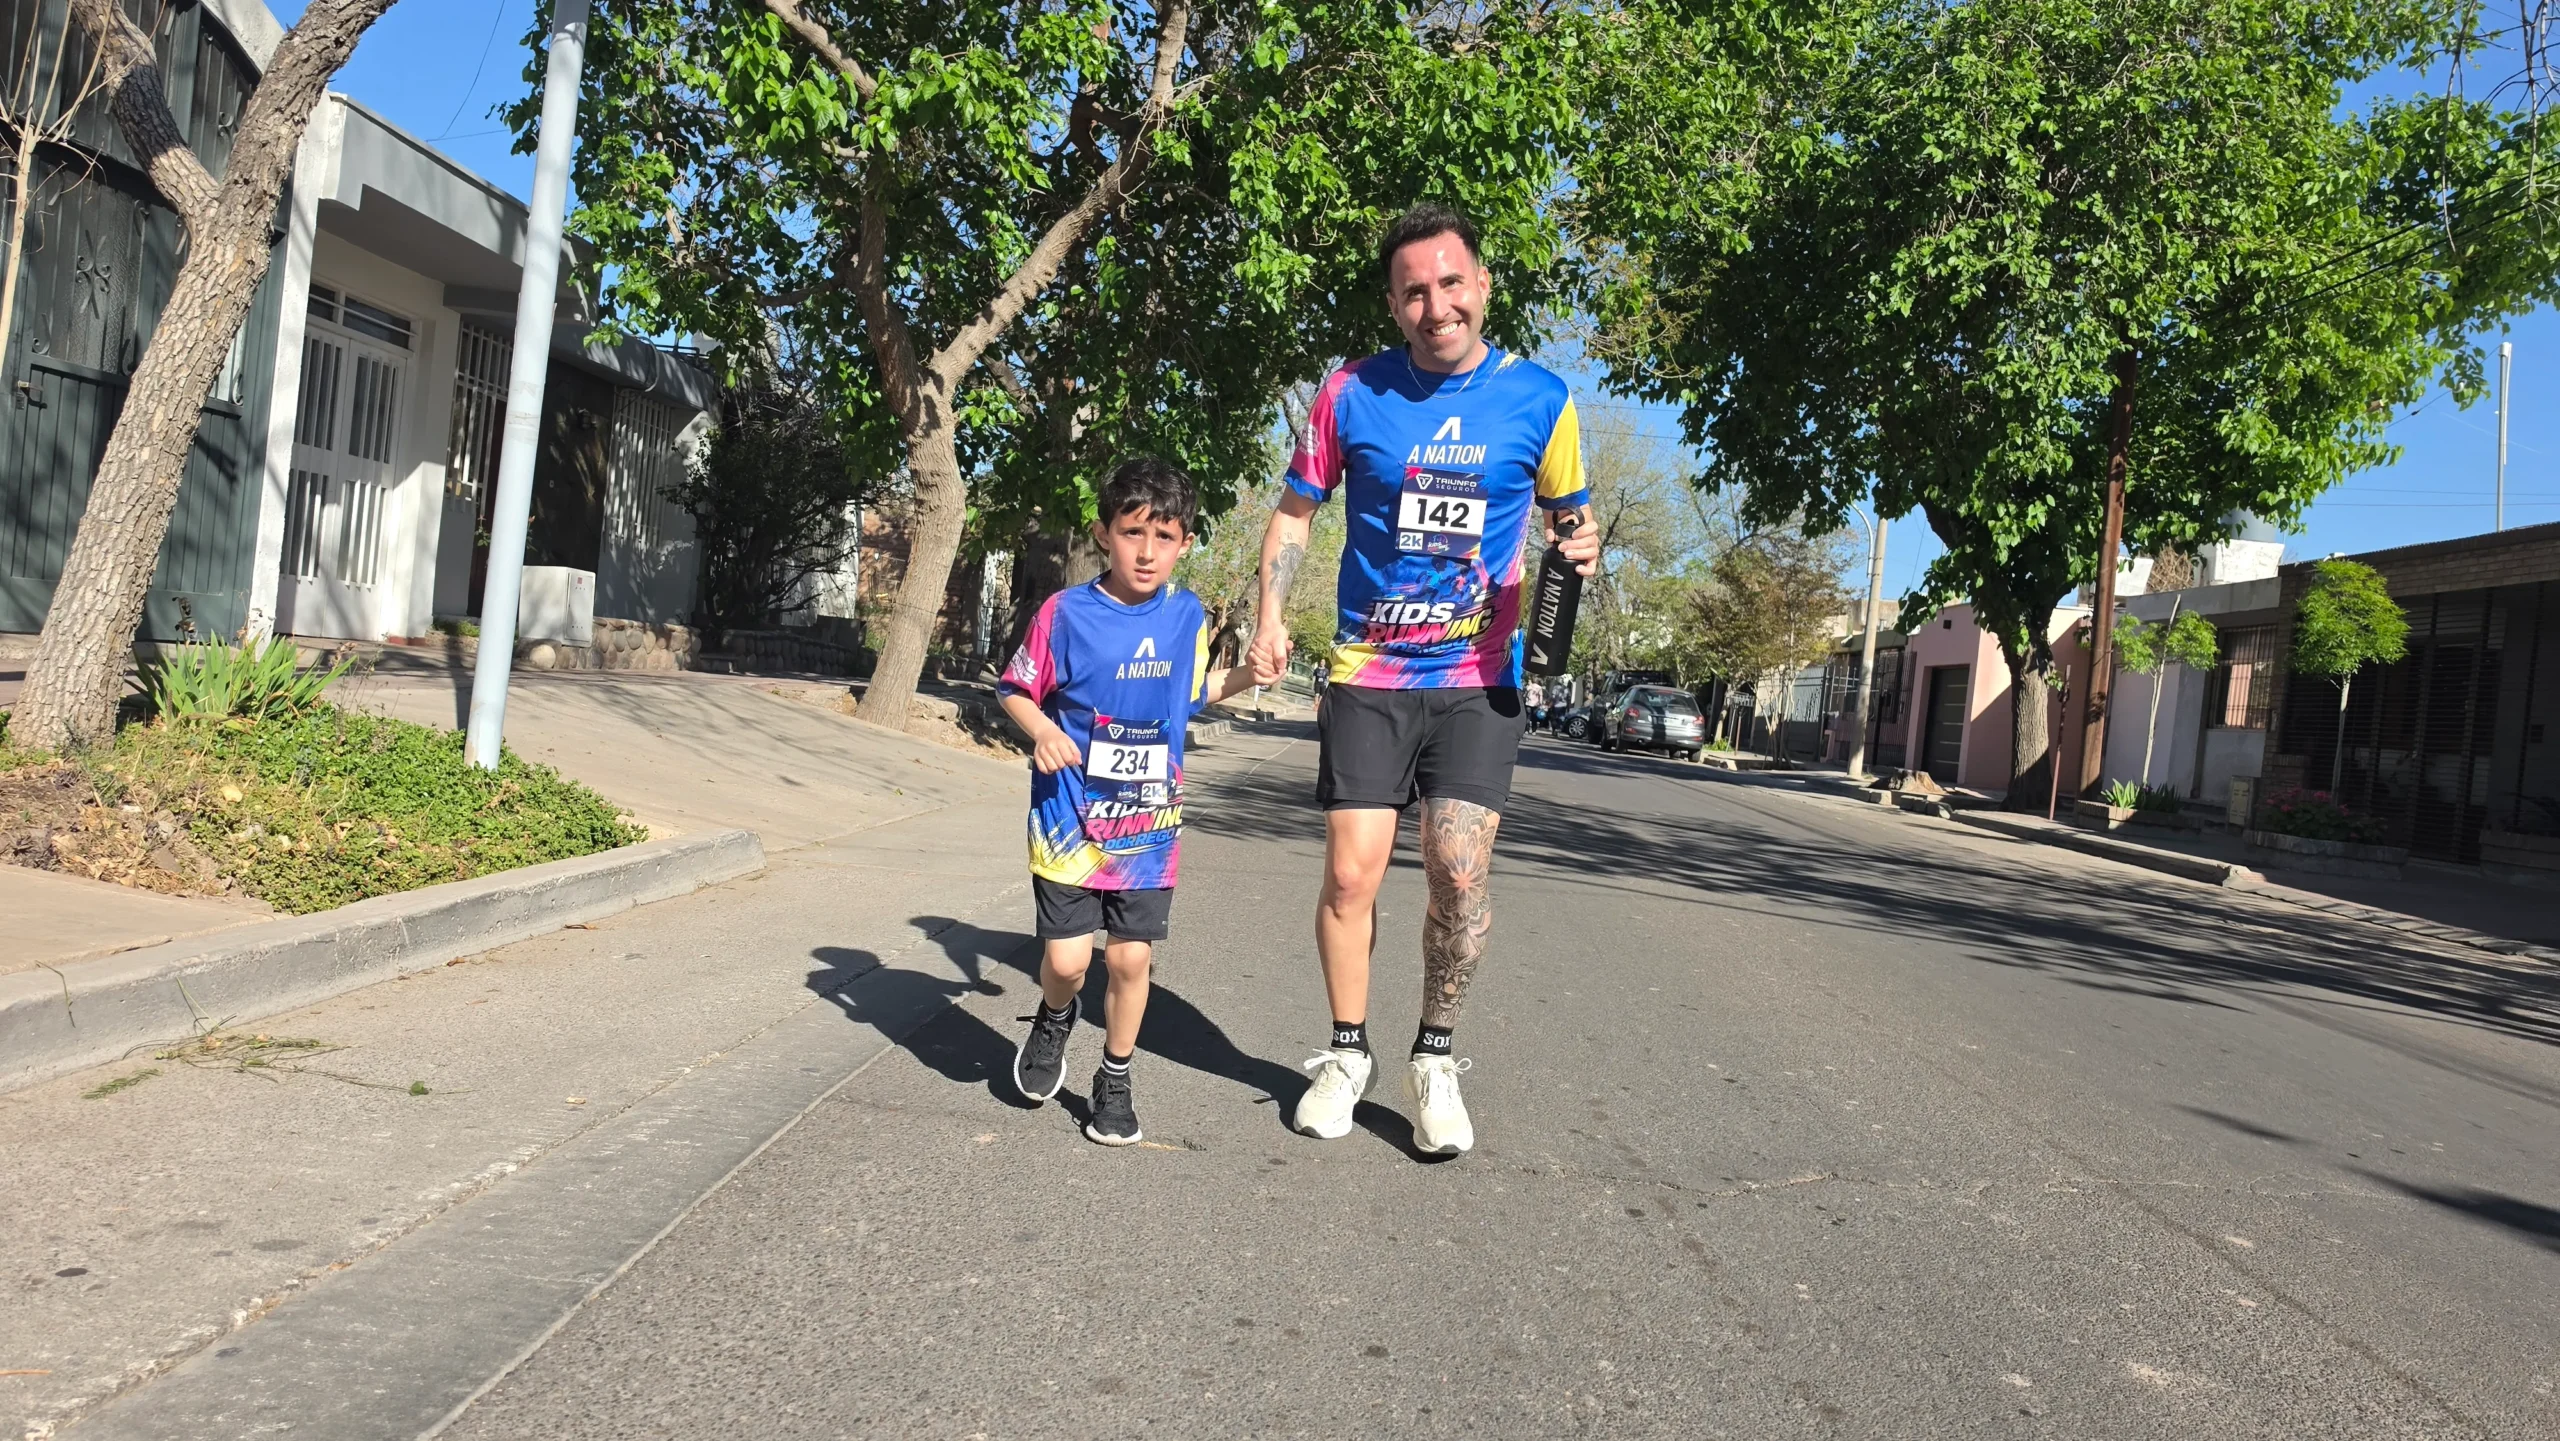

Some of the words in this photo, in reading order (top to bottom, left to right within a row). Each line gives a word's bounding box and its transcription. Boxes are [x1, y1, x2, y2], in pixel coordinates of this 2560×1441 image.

[1406, 444, 1420, 464] A
[1422, 444, 1487, 465] NATION
[1435, 476, 1477, 488] TRIUNFO
[1435, 484, 1475, 493] SEGUROS
[1417, 498, 1470, 529] 142
[1546, 567, 1564, 581] A
[1370, 602, 1455, 624] KIDS
[1536, 581, 1562, 638] NATION
[1364, 608, 1492, 643] RUNNING
[1115, 663, 1125, 680] A
[1128, 660, 1172, 679] NATION
[1110, 748, 1150, 775] 234
[1104, 828, 1175, 849] DORREGO
[1333, 1029, 1360, 1043] SOX
[1423, 1032, 1451, 1048] SOX
